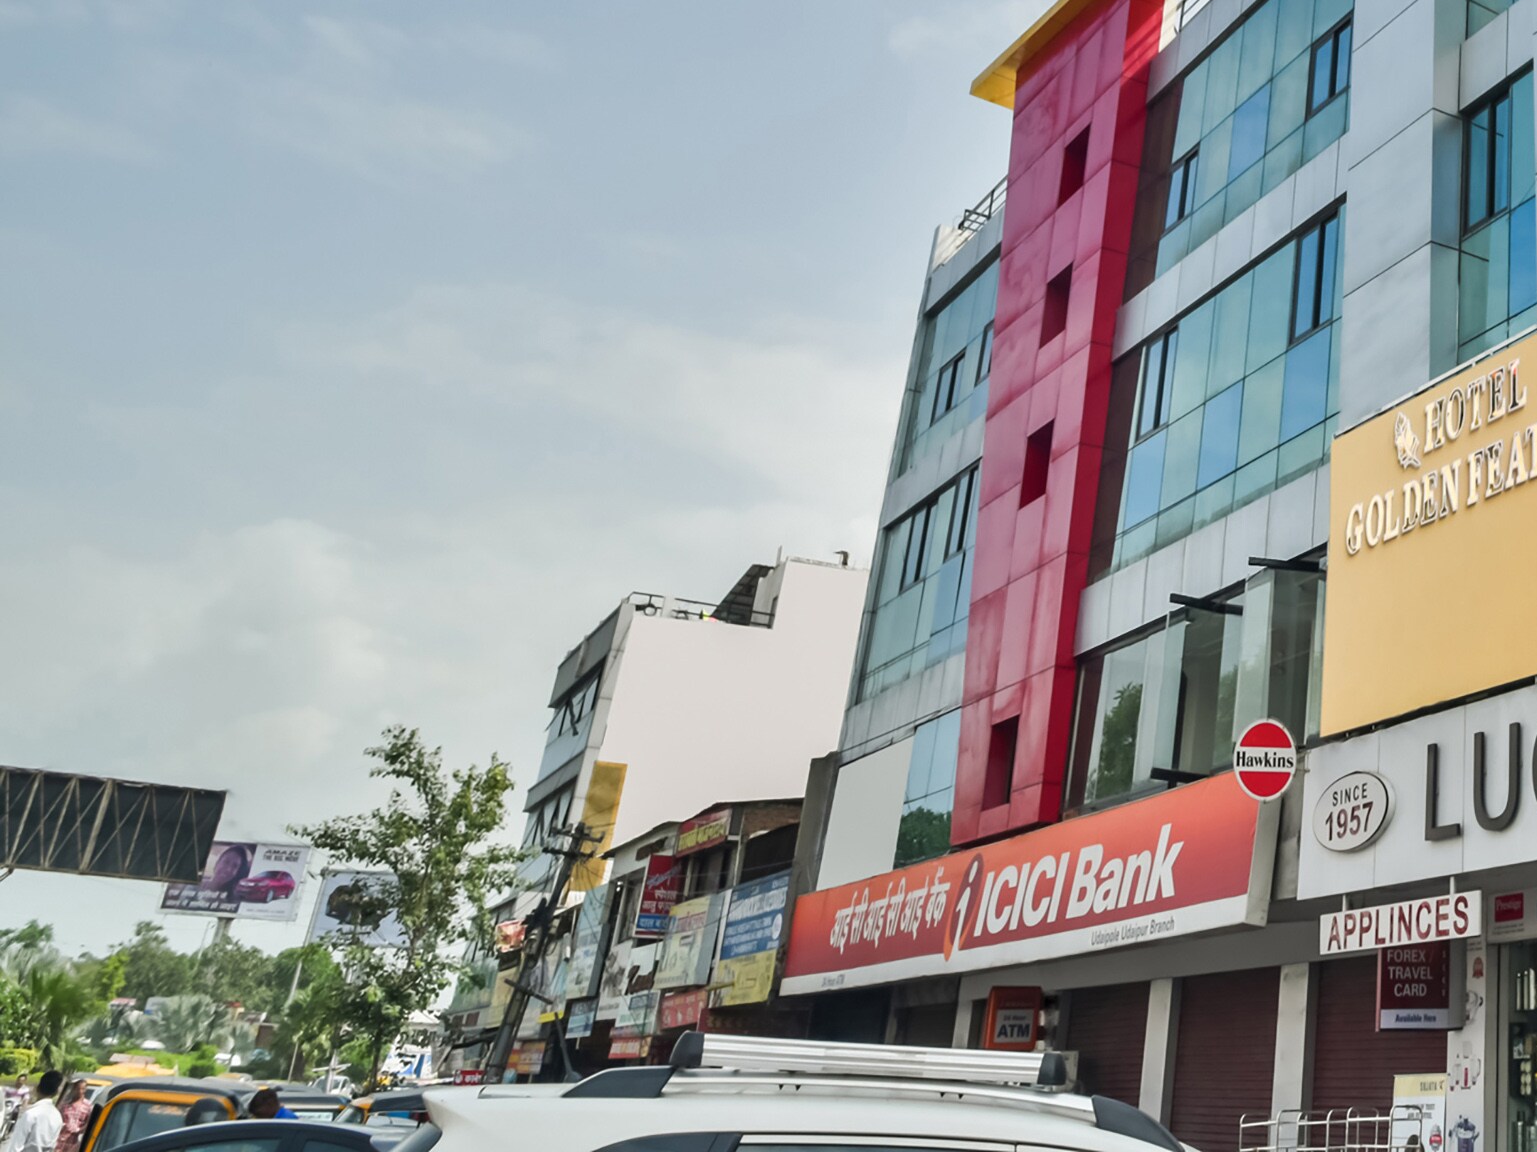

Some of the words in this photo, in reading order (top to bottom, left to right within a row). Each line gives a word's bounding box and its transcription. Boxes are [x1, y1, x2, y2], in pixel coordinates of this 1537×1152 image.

[1423, 357, 1528, 454] HOTEL
[1345, 458, 1461, 555] GOLDEN
[1236, 751, 1294, 768] Hawkins
[1332, 782, 1368, 806] SINCE
[1325, 801, 1374, 841] 1957
[973, 852, 1070, 938] ICICI
[1066, 822, 1185, 921] Bank
[830, 891, 858, 955] आई
[850, 887, 869, 945] सी
[863, 881, 893, 949] आई
[885, 876, 906, 938] सी
[901, 875, 929, 940] आई
[1496, 898, 1522, 911] Prestige
[1091, 929, 1119, 946] Udaipole
[1121, 923, 1148, 941] Udaipur
[1149, 916, 1175, 934] Branch
[1327, 895, 1469, 951] APPLINCES
[1387, 949, 1426, 963] FOREX
[1388, 965, 1433, 980] TRAVEL
[1394, 983, 1427, 997] CARD
[1395, 1013, 1422, 1023] Available
[997, 1024, 1030, 1038] ATM
